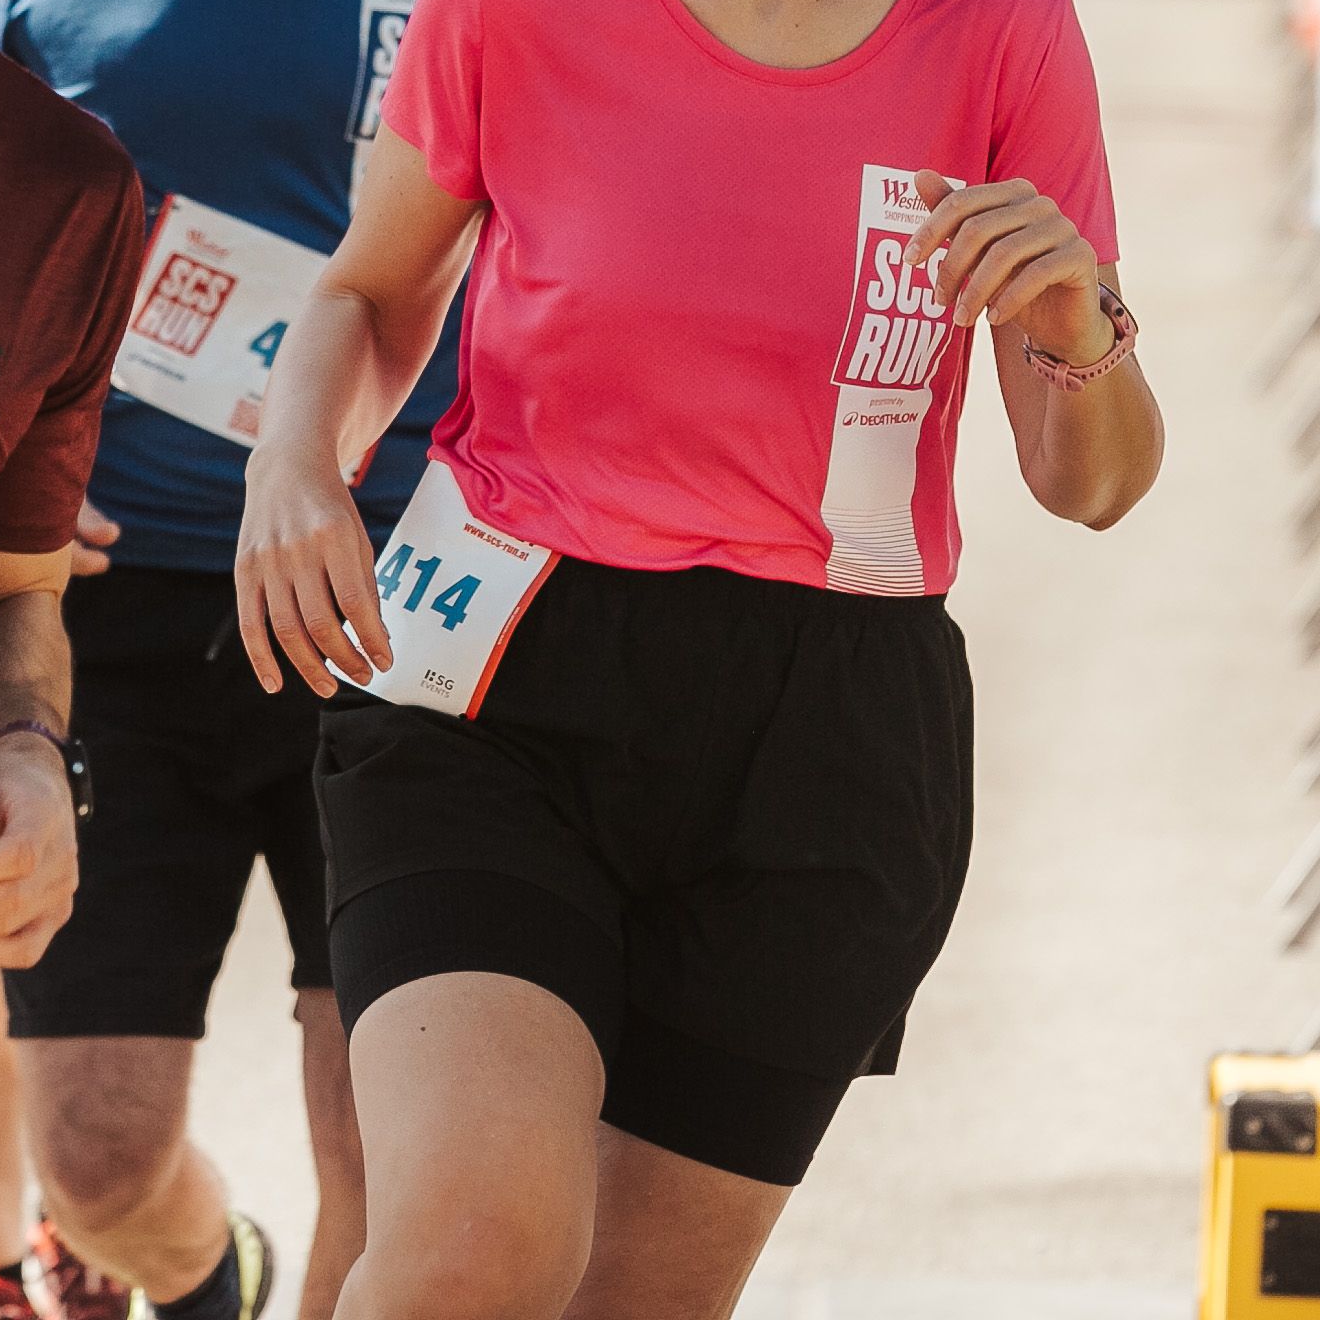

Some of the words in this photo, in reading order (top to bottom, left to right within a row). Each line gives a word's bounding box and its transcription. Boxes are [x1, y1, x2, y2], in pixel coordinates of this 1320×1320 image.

[846, 312, 946, 386] RUN
[860, 412, 918, 426] DECATHLON
[463, 522, 530, 562] www.scs-run.at
[375, 543, 482, 632] 414
